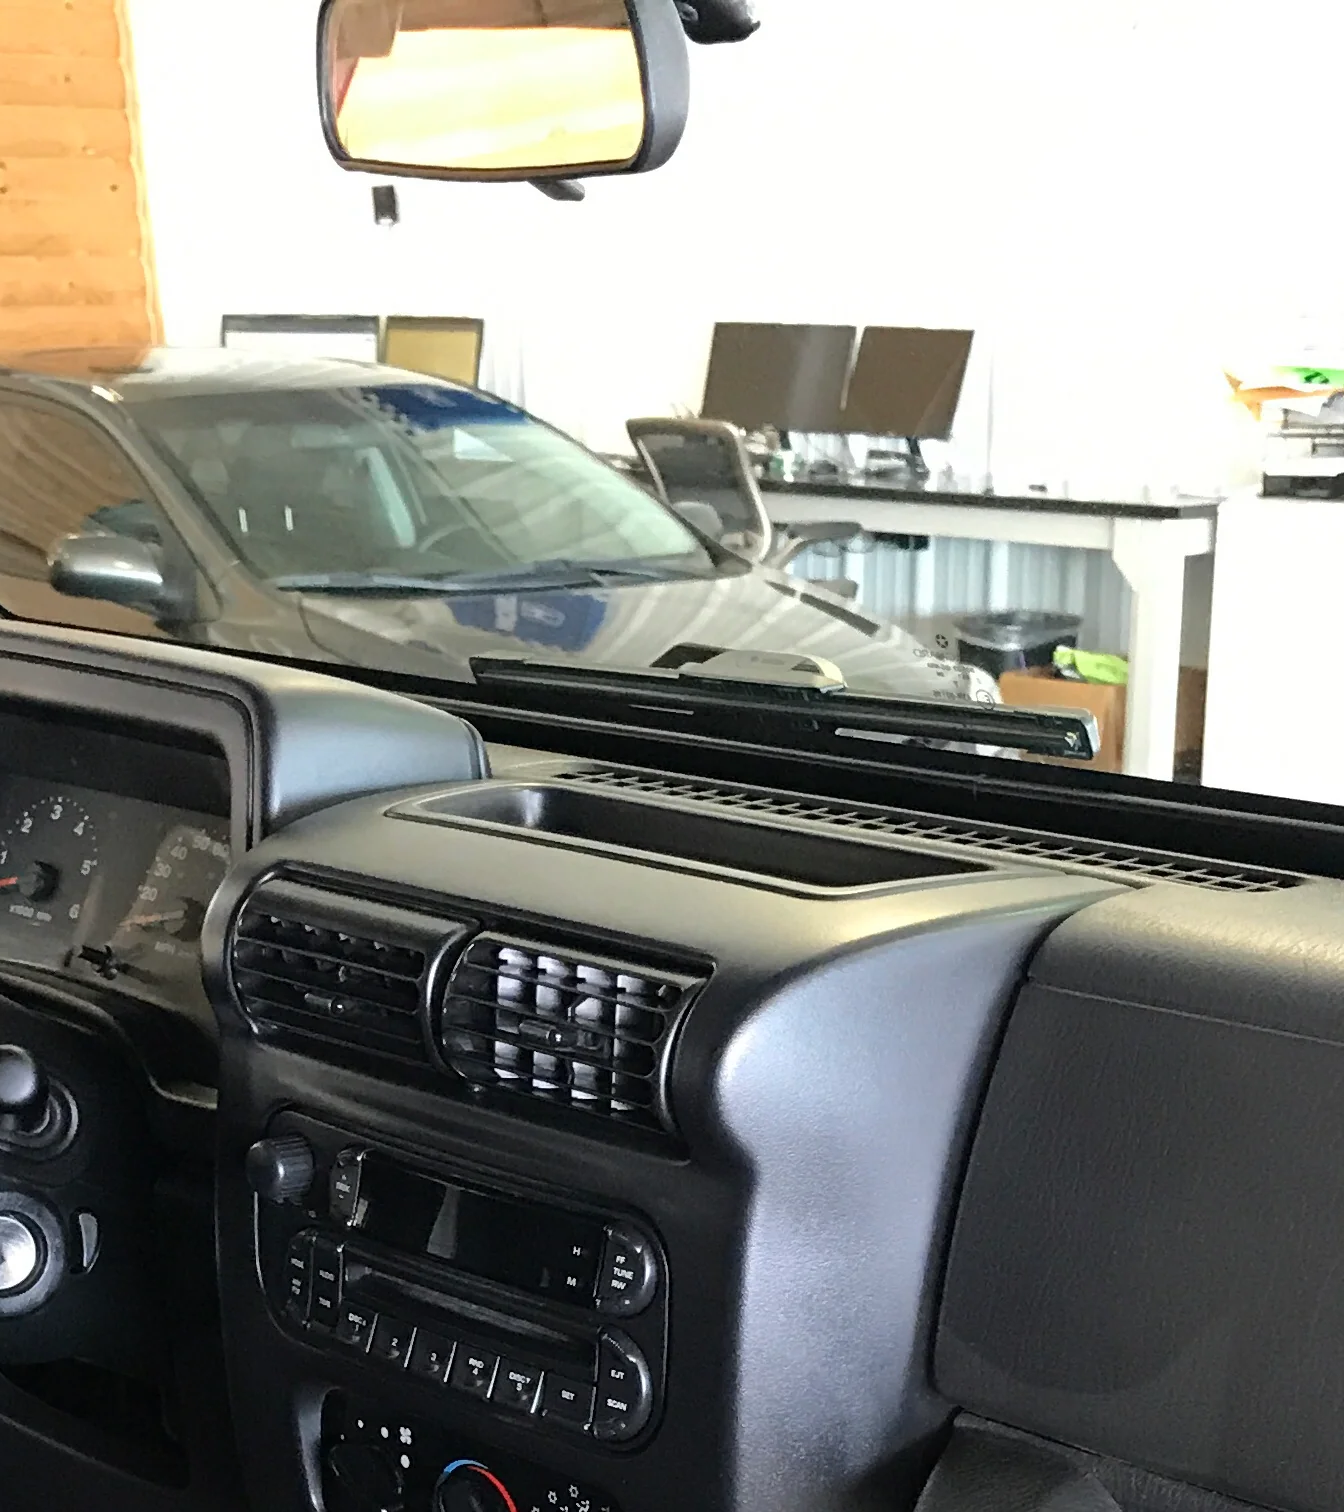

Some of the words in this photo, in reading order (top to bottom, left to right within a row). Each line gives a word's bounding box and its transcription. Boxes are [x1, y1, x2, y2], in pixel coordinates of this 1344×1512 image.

[51, 804, 63, 820] 3
[21, 818, 33, 833] 2
[572, 1245, 581, 1256] H
[613, 1266, 634, 1280] TUNE
[566, 1276, 577, 1287] M
[391, 1337, 399, 1348] 2
